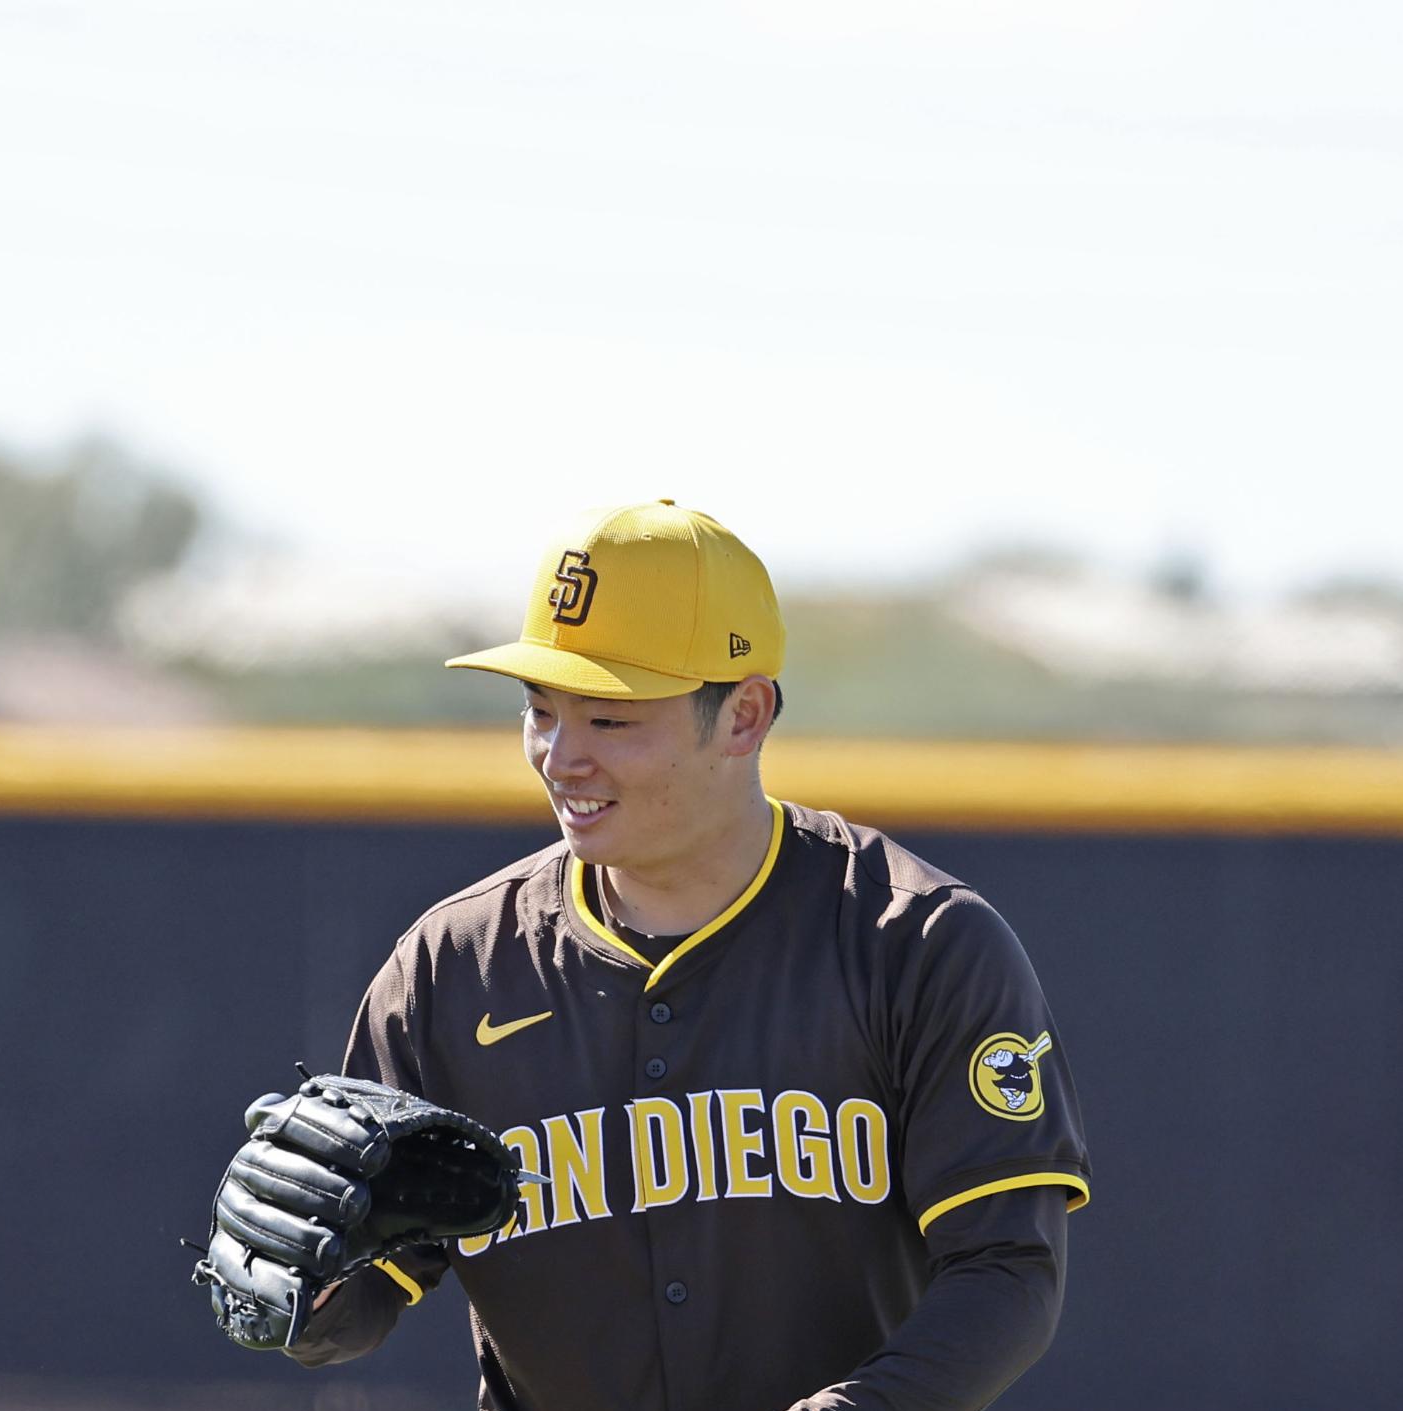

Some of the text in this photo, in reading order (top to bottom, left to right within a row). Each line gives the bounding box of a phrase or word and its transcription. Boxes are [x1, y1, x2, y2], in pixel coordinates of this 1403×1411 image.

[549, 549, 598, 626] SD
[458, 1088, 891, 1257] AN DIEGO
